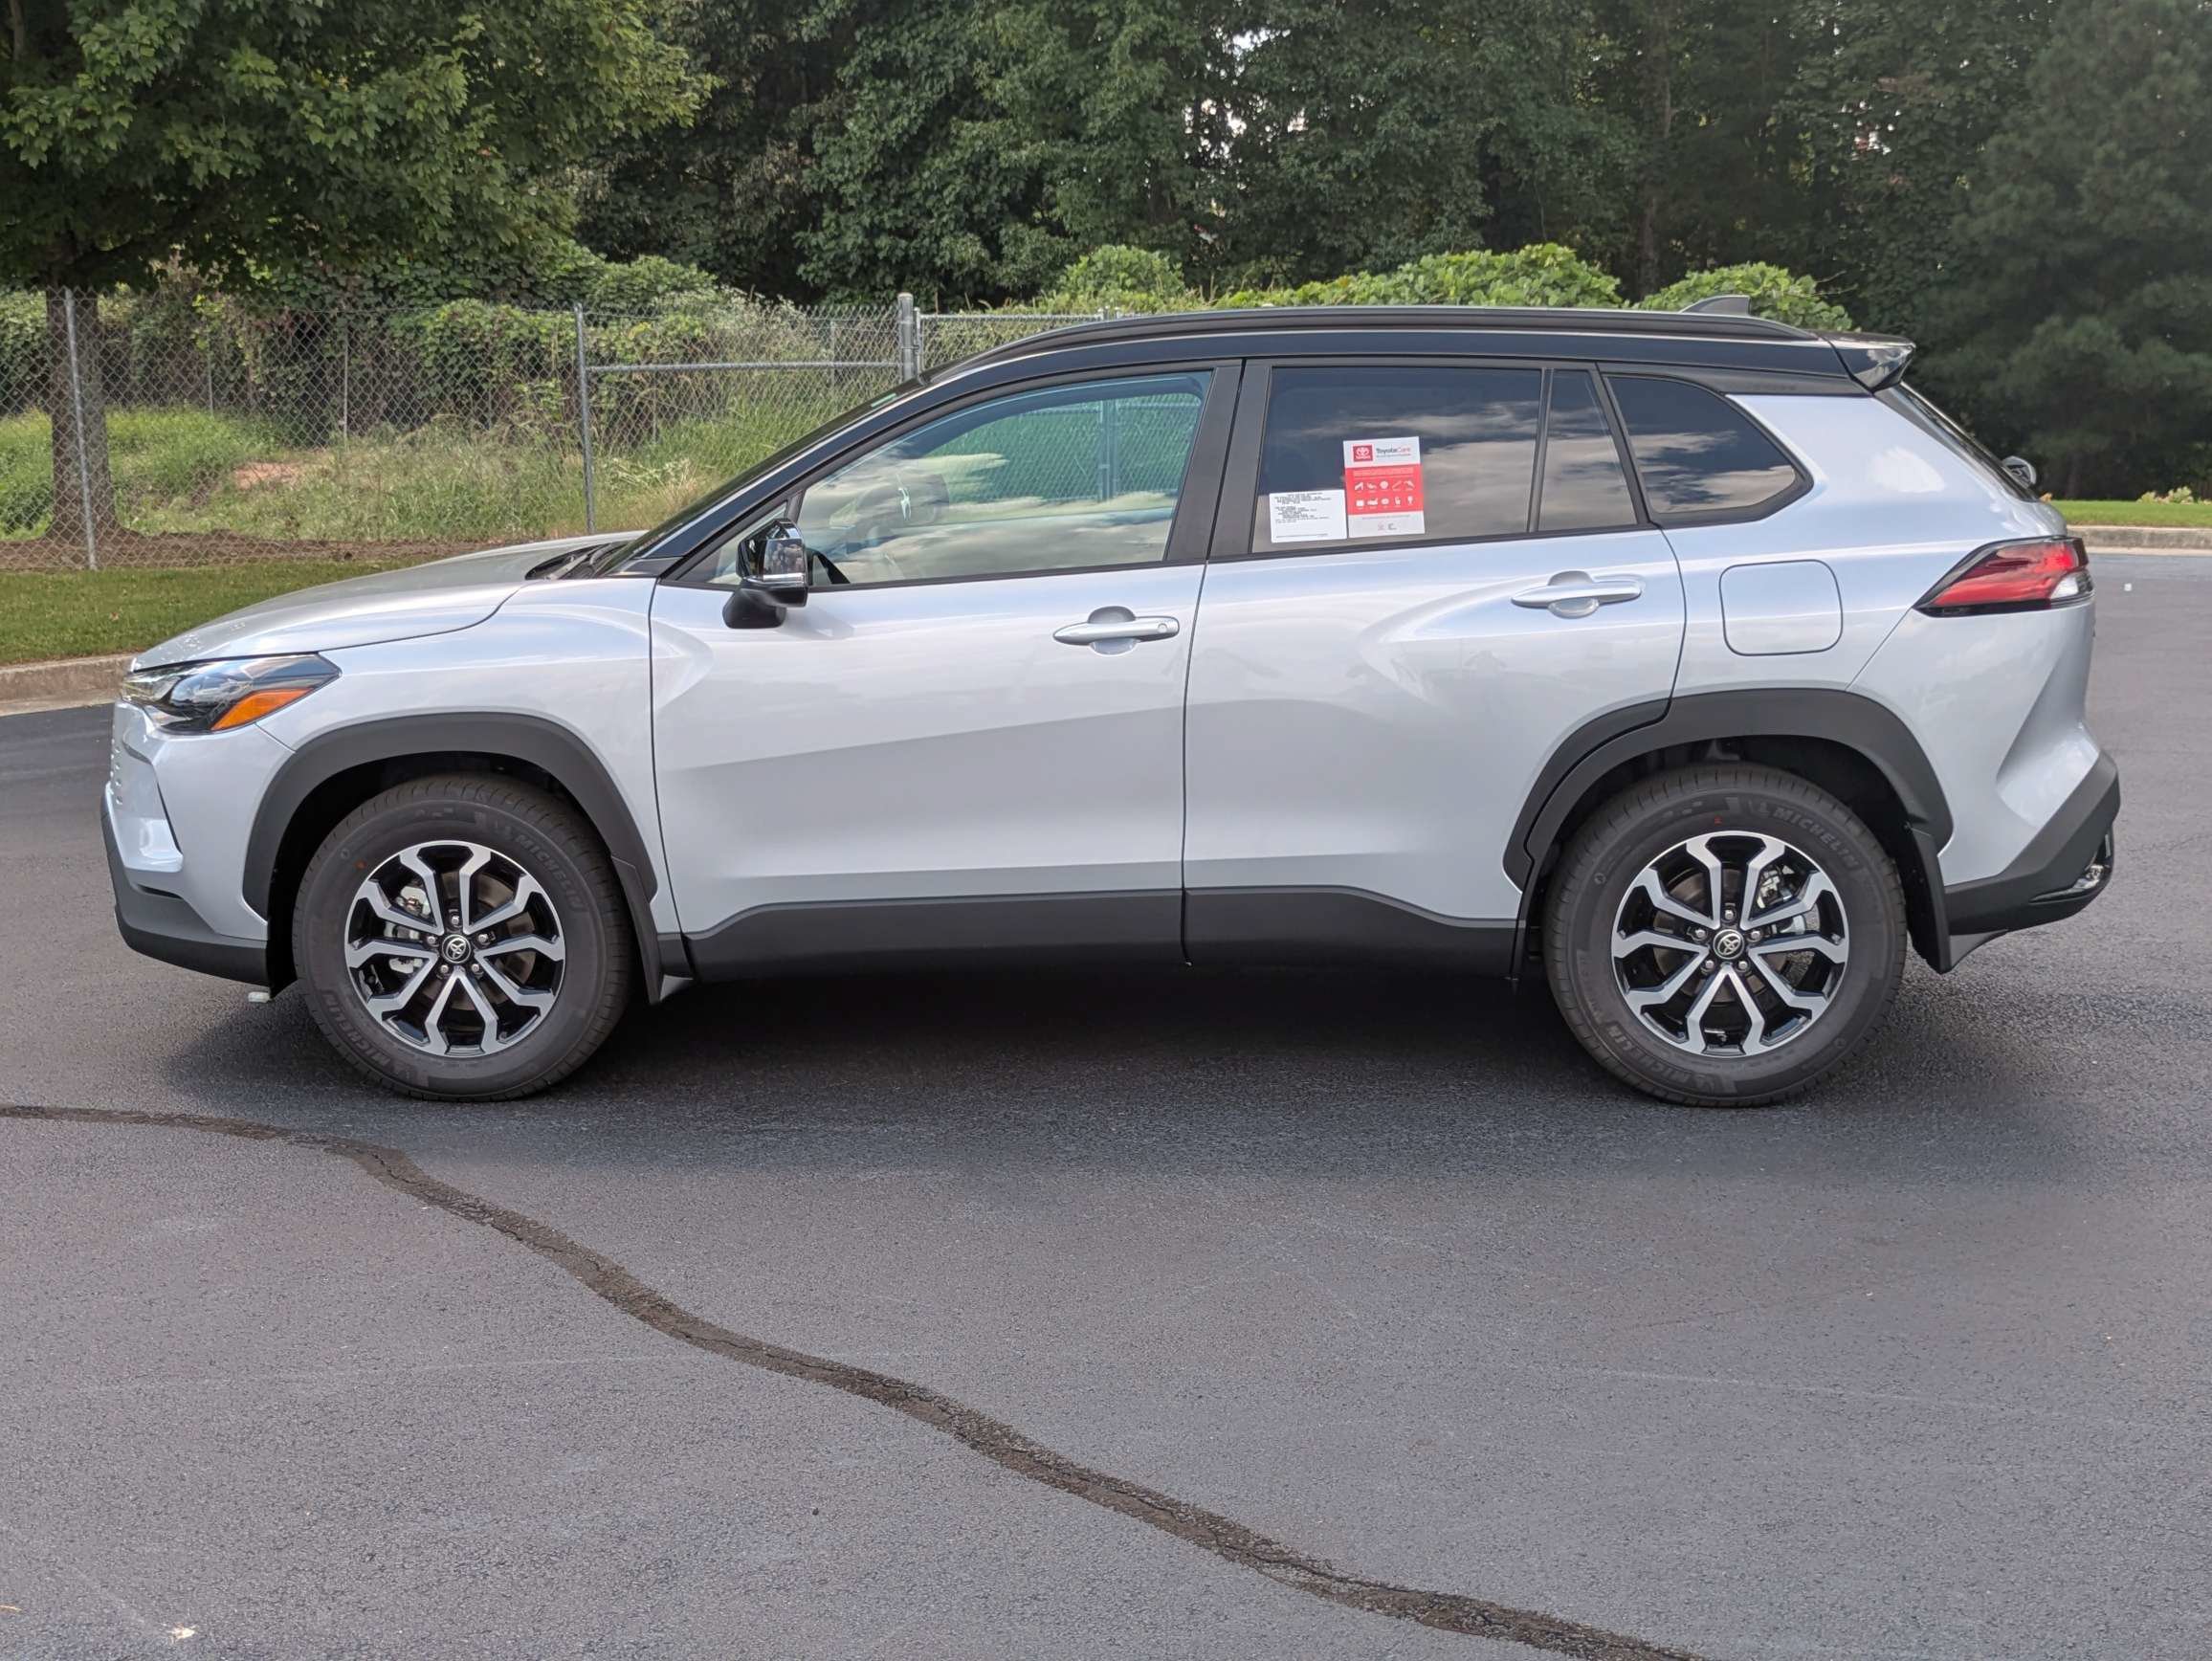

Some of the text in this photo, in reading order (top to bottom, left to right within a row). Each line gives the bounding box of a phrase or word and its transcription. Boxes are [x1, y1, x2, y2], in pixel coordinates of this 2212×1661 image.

[1376, 446, 1411, 454] ToyotaCare
[1772, 806, 1860, 868] MICHELIN
[518, 834, 585, 911] MICHELIN
[323, 994, 392, 1070] MICHELIN
[1606, 1025, 1692, 1085] MICHELIN
